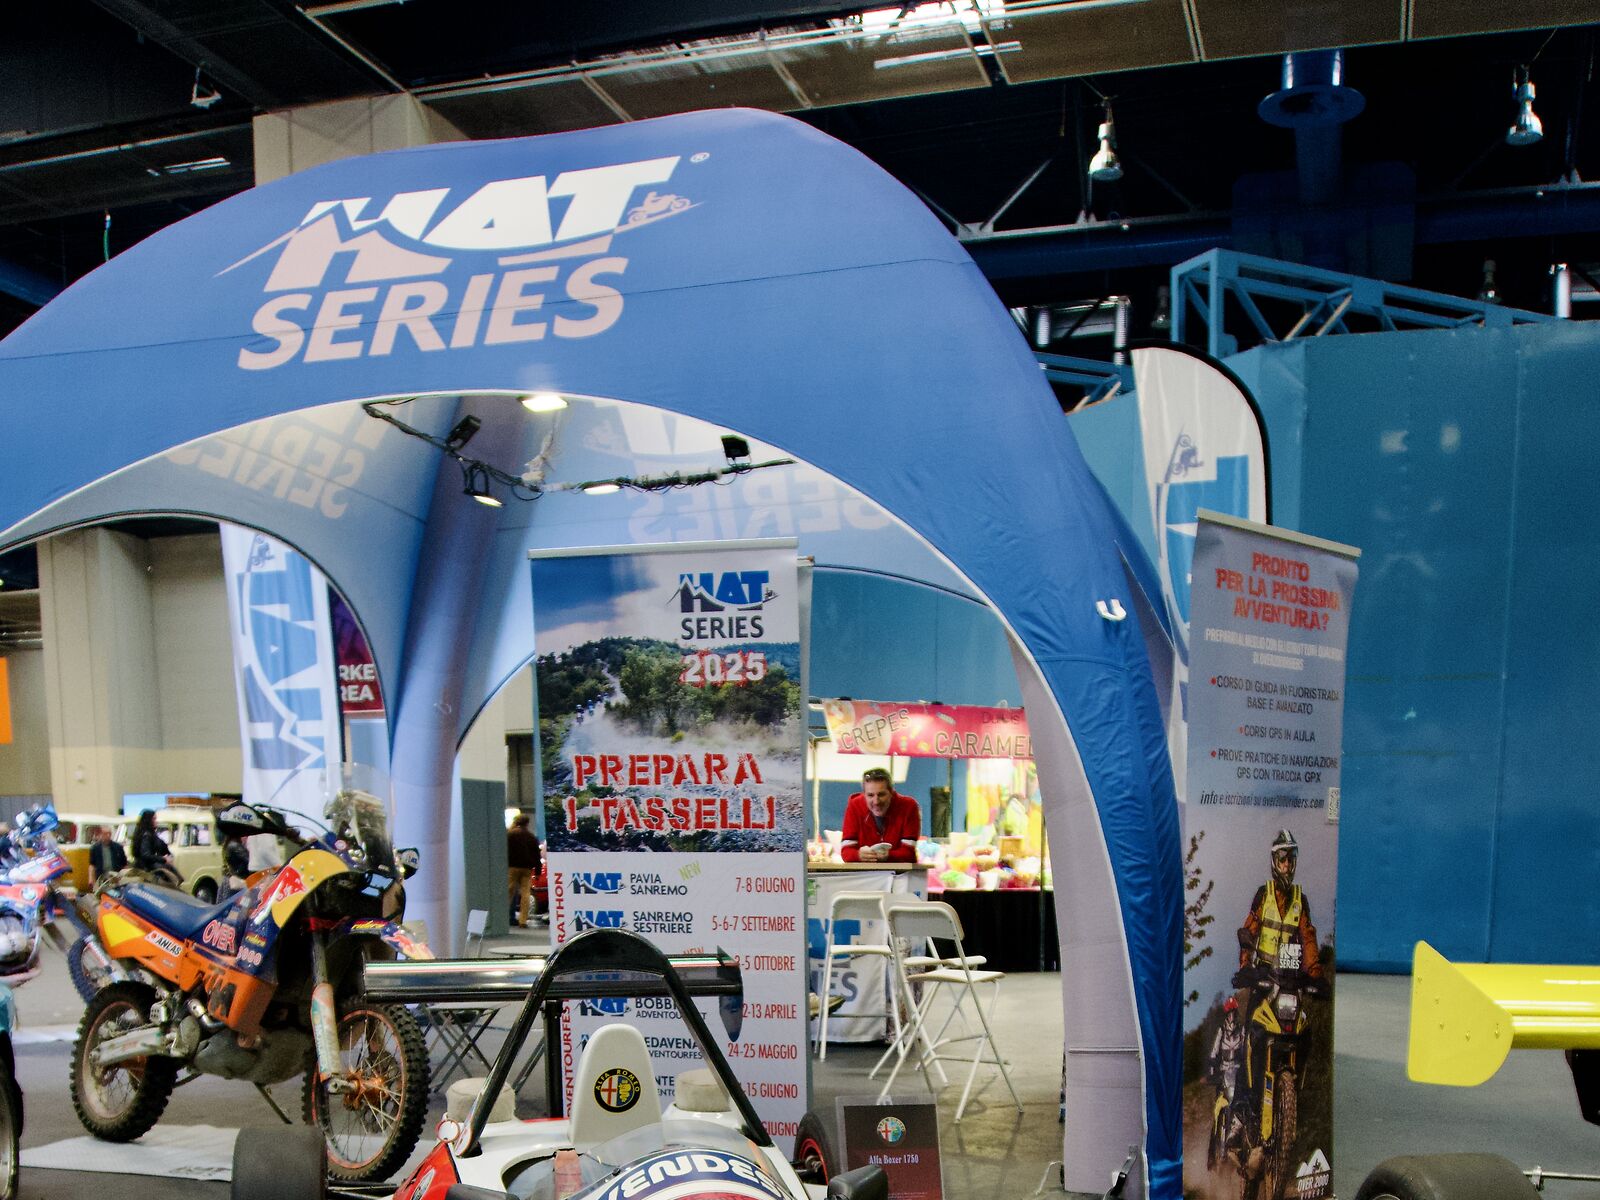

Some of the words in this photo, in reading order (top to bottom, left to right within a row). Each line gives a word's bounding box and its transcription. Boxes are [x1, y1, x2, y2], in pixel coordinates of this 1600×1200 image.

[261, 155, 682, 293] HAT
[236, 257, 630, 371] SERIES
[1252, 551, 1310, 582] PRONTO
[679, 570, 770, 613] HAT
[1215, 567, 1244, 593] PER
[1248, 575, 1267, 599] LA
[1272, 579, 1340, 611] PROSSIMA
[1234, 596, 1330, 631] AVVENTURA?
[680, 615, 764, 641] SERIES
[682, 652, 766, 685] 2025
[1216, 675, 1244, 691] CORSO
[1245, 680, 1253, 691] DI
[1255, 681, 1278, 695] GUIDA
[1247, 697, 1266, 710] BASE
[1269, 699, 1274, 710] E
[1276, 700, 1314, 715] AVANZATO
[840, 709, 910, 750] CREPES
[1244, 724, 1267, 739] CORSI
[1268, 727, 1282, 740] GPS
[1284, 730, 1291, 741] IN
[1293, 730, 1316, 743] AULA
[1218, 748, 1243, 763] PROVE
[1244, 751, 1280, 766] PRATICHE
[1281, 754, 1289, 766] DI
[574, 752, 764, 788] PREPARA
[1236, 766, 1251, 779] GPS
[1253, 767, 1270, 781] CON
[1272, 769, 1302, 783] TRACCIA
[1304, 770, 1322, 783] GPX
[1200, 790, 1218, 805] info
[566, 796, 578, 832] I
[590, 795, 777, 832] TASSELLI
[572, 872, 623, 894] HAT
[630, 873, 661, 884] PAVIA
[735, 877, 752, 893] 7-8
[755, 877, 796, 893] GIUGNO
[630, 884, 688, 896] SANREMO
[574, 911, 624, 931] HAT
[633, 911, 693, 923] SANREMO
[711, 915, 739, 931] 5-6-7
[741, 916, 796, 932] SETTEMBRE
[633, 923, 692, 934] SESTRIERE
[157, 936, 182, 956] ANLAS
[753, 955, 796, 971] OTTOBRE
[764, 1004, 798, 1020] APRILE
[727, 1042, 756, 1058] 24-25
[758, 1043, 798, 1060] MAGGIO
[595, 1072, 610, 1091] ALFA
[616, 1069, 640, 1092] ROMEO
[760, 1083, 798, 1099] GIUGNO
